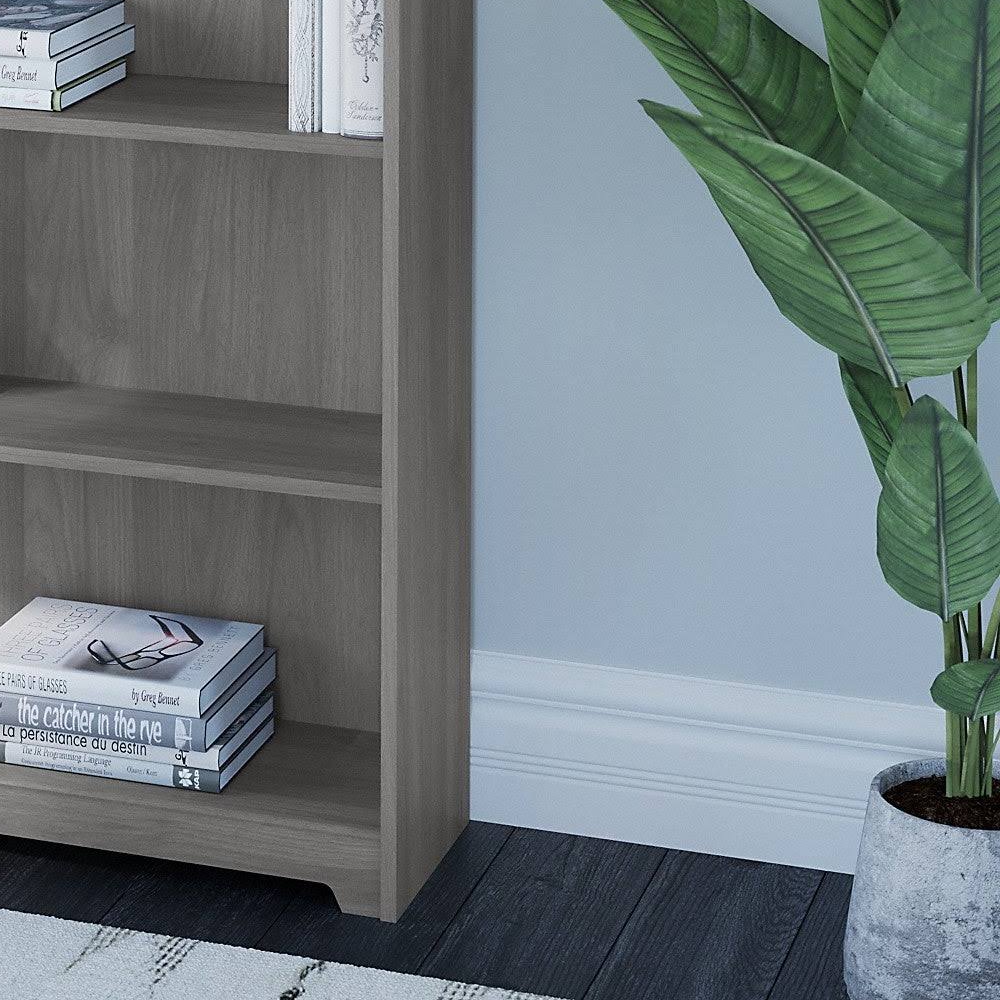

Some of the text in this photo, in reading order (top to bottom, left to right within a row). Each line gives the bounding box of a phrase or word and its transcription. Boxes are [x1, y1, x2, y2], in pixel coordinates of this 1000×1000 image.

[1, 64, 16, 82] Greg
[17, 65, 38, 82] Bennet
[38, 606, 99, 646] GLASSES
[7, 672, 25, 689] PAIRS
[27, 674, 37, 690] OF
[38, 676, 68, 695] GLASSES
[131, 687, 180, 708] by Greg Bennet
[17, 696, 39, 728] the
[43, 703, 95, 736] catcher
[97, 706, 110, 737] in
[114, 709, 137, 741] the
[139, 719, 162, 746] rye
[2, 724, 147, 757] La persistance du destin
[22, 745, 33, 755] The
[43, 747, 82, 764] Programming
[83, 753, 112, 768] Language
